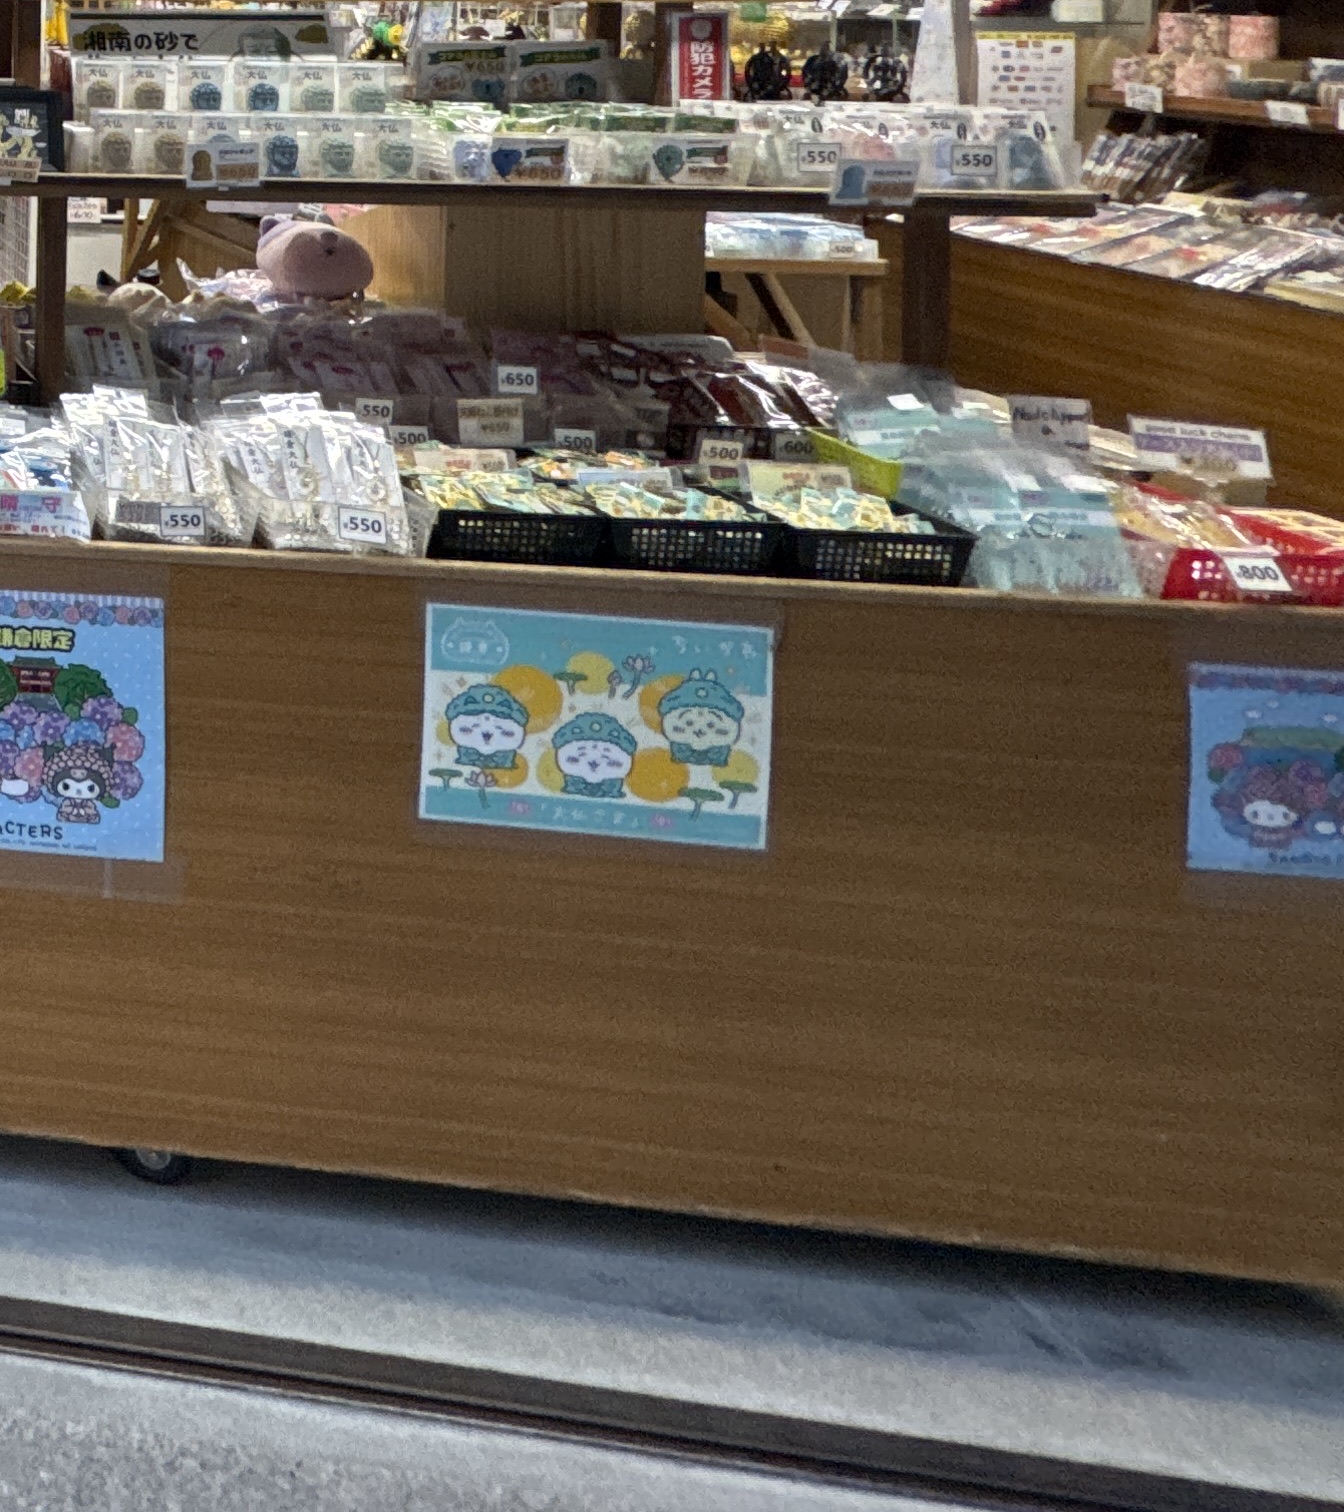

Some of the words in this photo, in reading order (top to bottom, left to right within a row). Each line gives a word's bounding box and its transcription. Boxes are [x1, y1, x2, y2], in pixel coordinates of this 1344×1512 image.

[84, 31, 200, 54] 湘南の砂で
[88, 68, 108, 78] 大仏
[135, 68, 155, 79] 大仏
[191, 69, 211, 80] 大仏
[247, 70, 268, 81] 大仏
[352, 70, 372, 81] 大仏
[690, 41, 714, 99] 防犯カメラ
[303, 71, 322, 81] 大仏
[103, 118, 123, 129] 大仏
[156, 119, 177, 130] 大仏
[206, 120, 227, 130] 大仏
[264, 121, 285, 132] 大仏
[321, 121, 342, 132] 大仏
[378, 122, 399, 133] 大仏
[502, 372, 535, 386] ¥650
[164, 513, 201, 528] ¥550
[343, 517, 382, 534] ¥550
